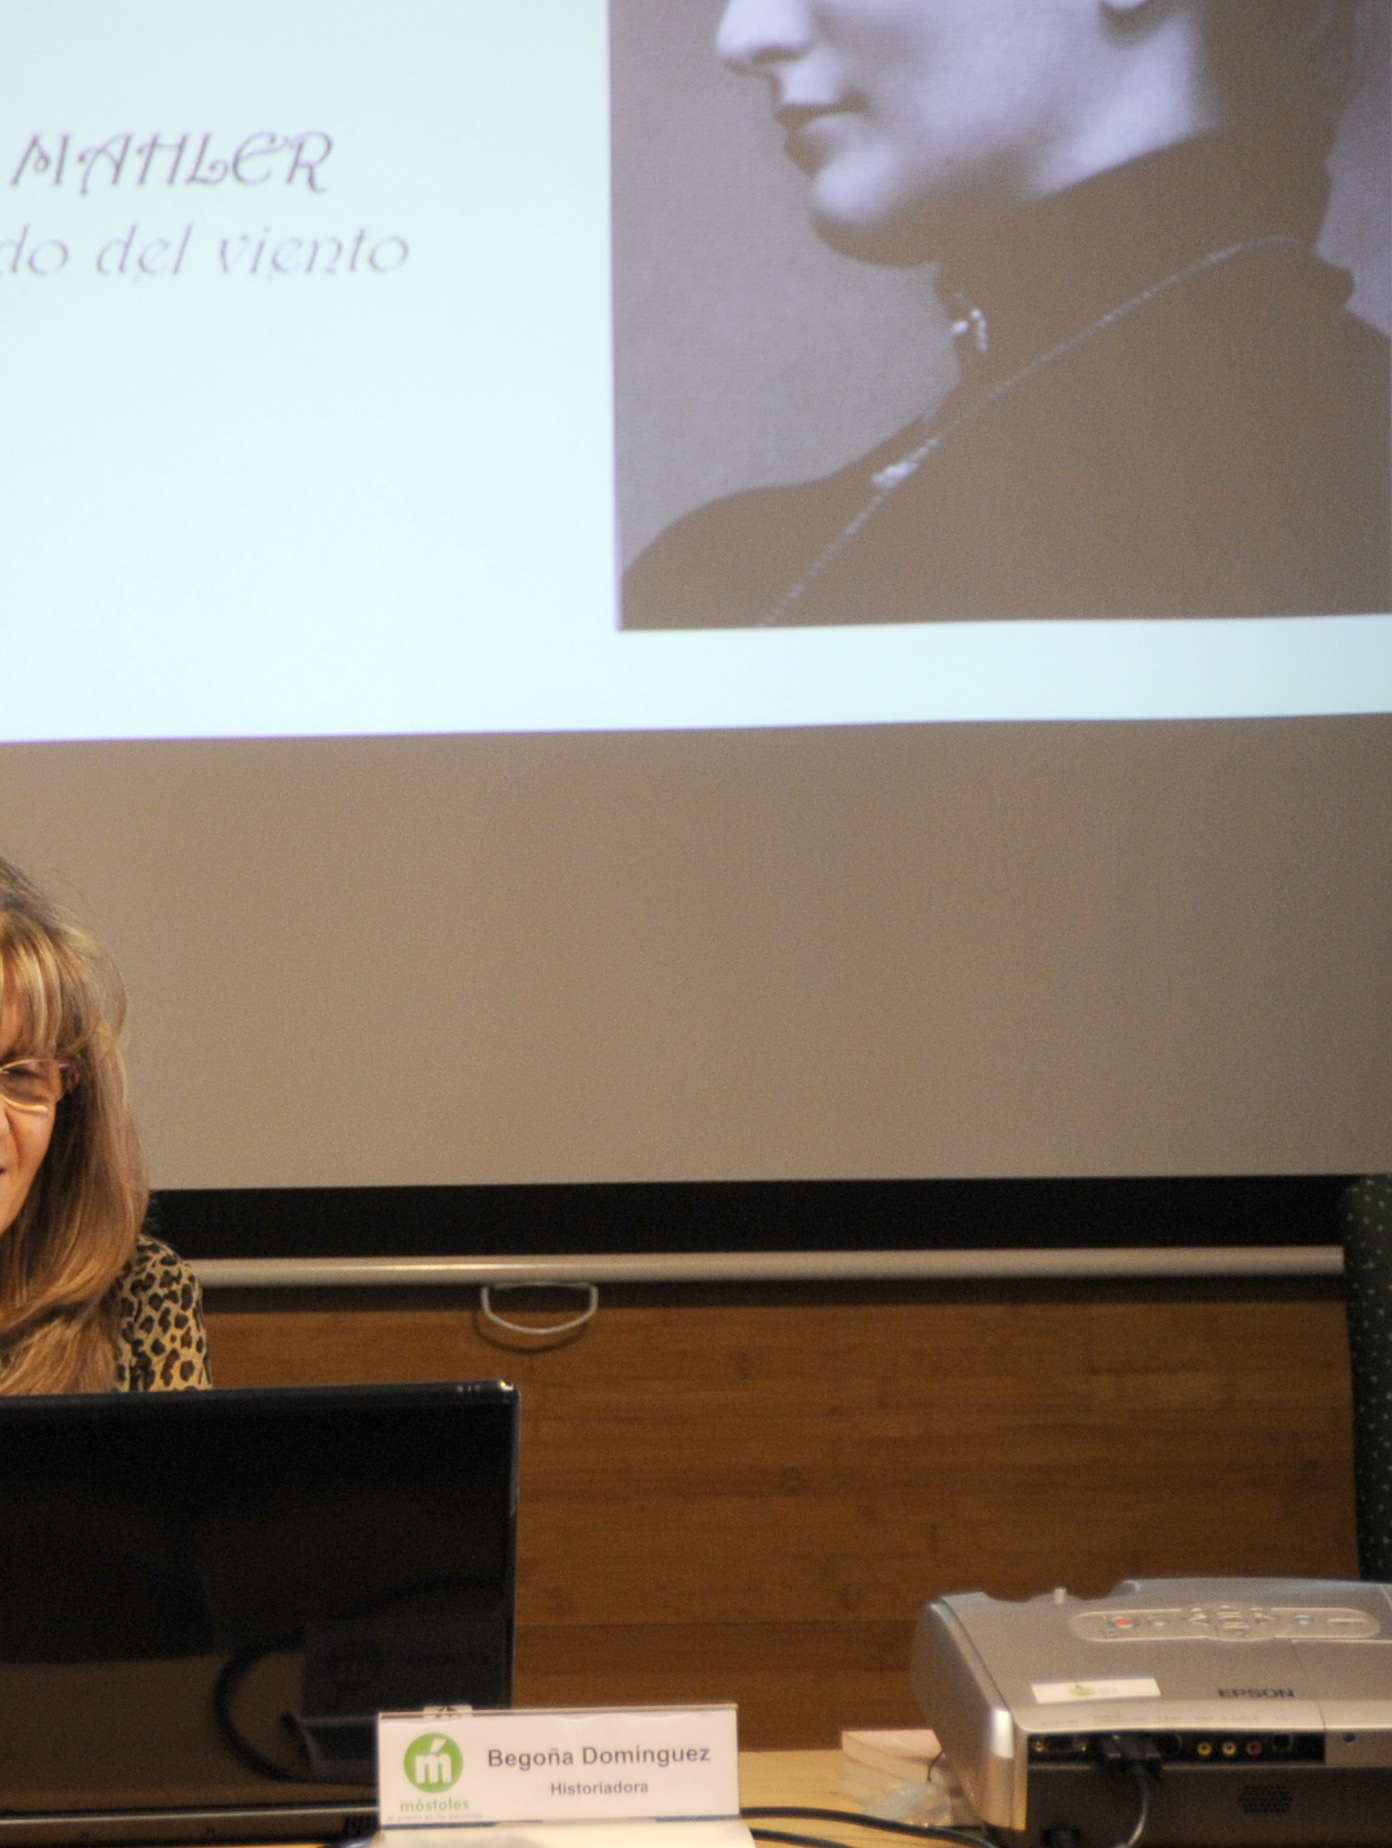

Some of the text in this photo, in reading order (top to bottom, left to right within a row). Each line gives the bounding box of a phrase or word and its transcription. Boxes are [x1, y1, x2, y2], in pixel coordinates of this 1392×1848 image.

[10, 131, 334, 197] MAHLER
[95, 222, 196, 281] del
[219, 226, 412, 280] viento
[1217, 1687, 1295, 1700] EPSON
[487, 1748, 574, 1772] Begoña
[550, 1780, 649, 1796] Historiadora
[399, 1796, 471, 1813] móstoles
